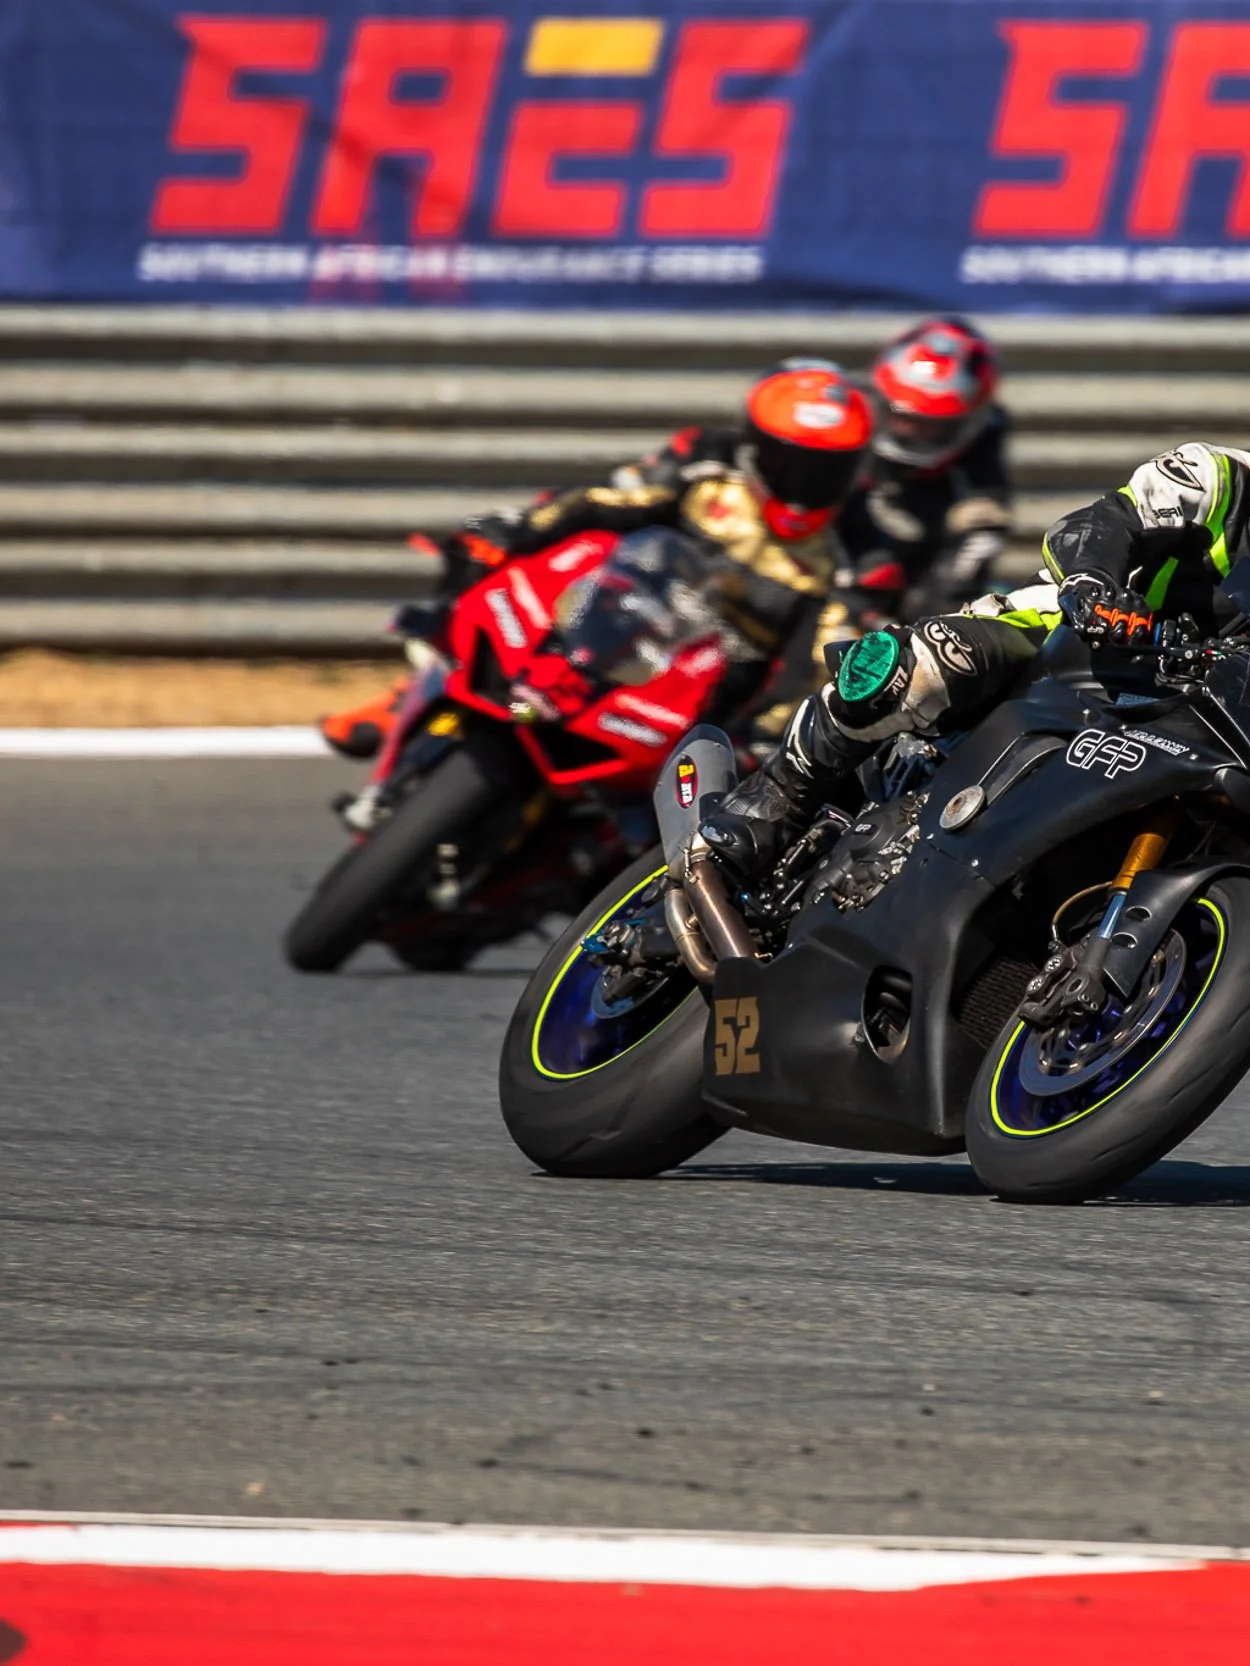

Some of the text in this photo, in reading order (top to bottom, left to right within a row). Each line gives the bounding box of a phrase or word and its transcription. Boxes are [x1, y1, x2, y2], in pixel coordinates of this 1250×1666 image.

[150, 18, 810, 236] SAES
[1152, 506, 1183, 520] BERI
[1066, 728, 1146, 779] GFP
[714, 996, 760, 1076] 52
